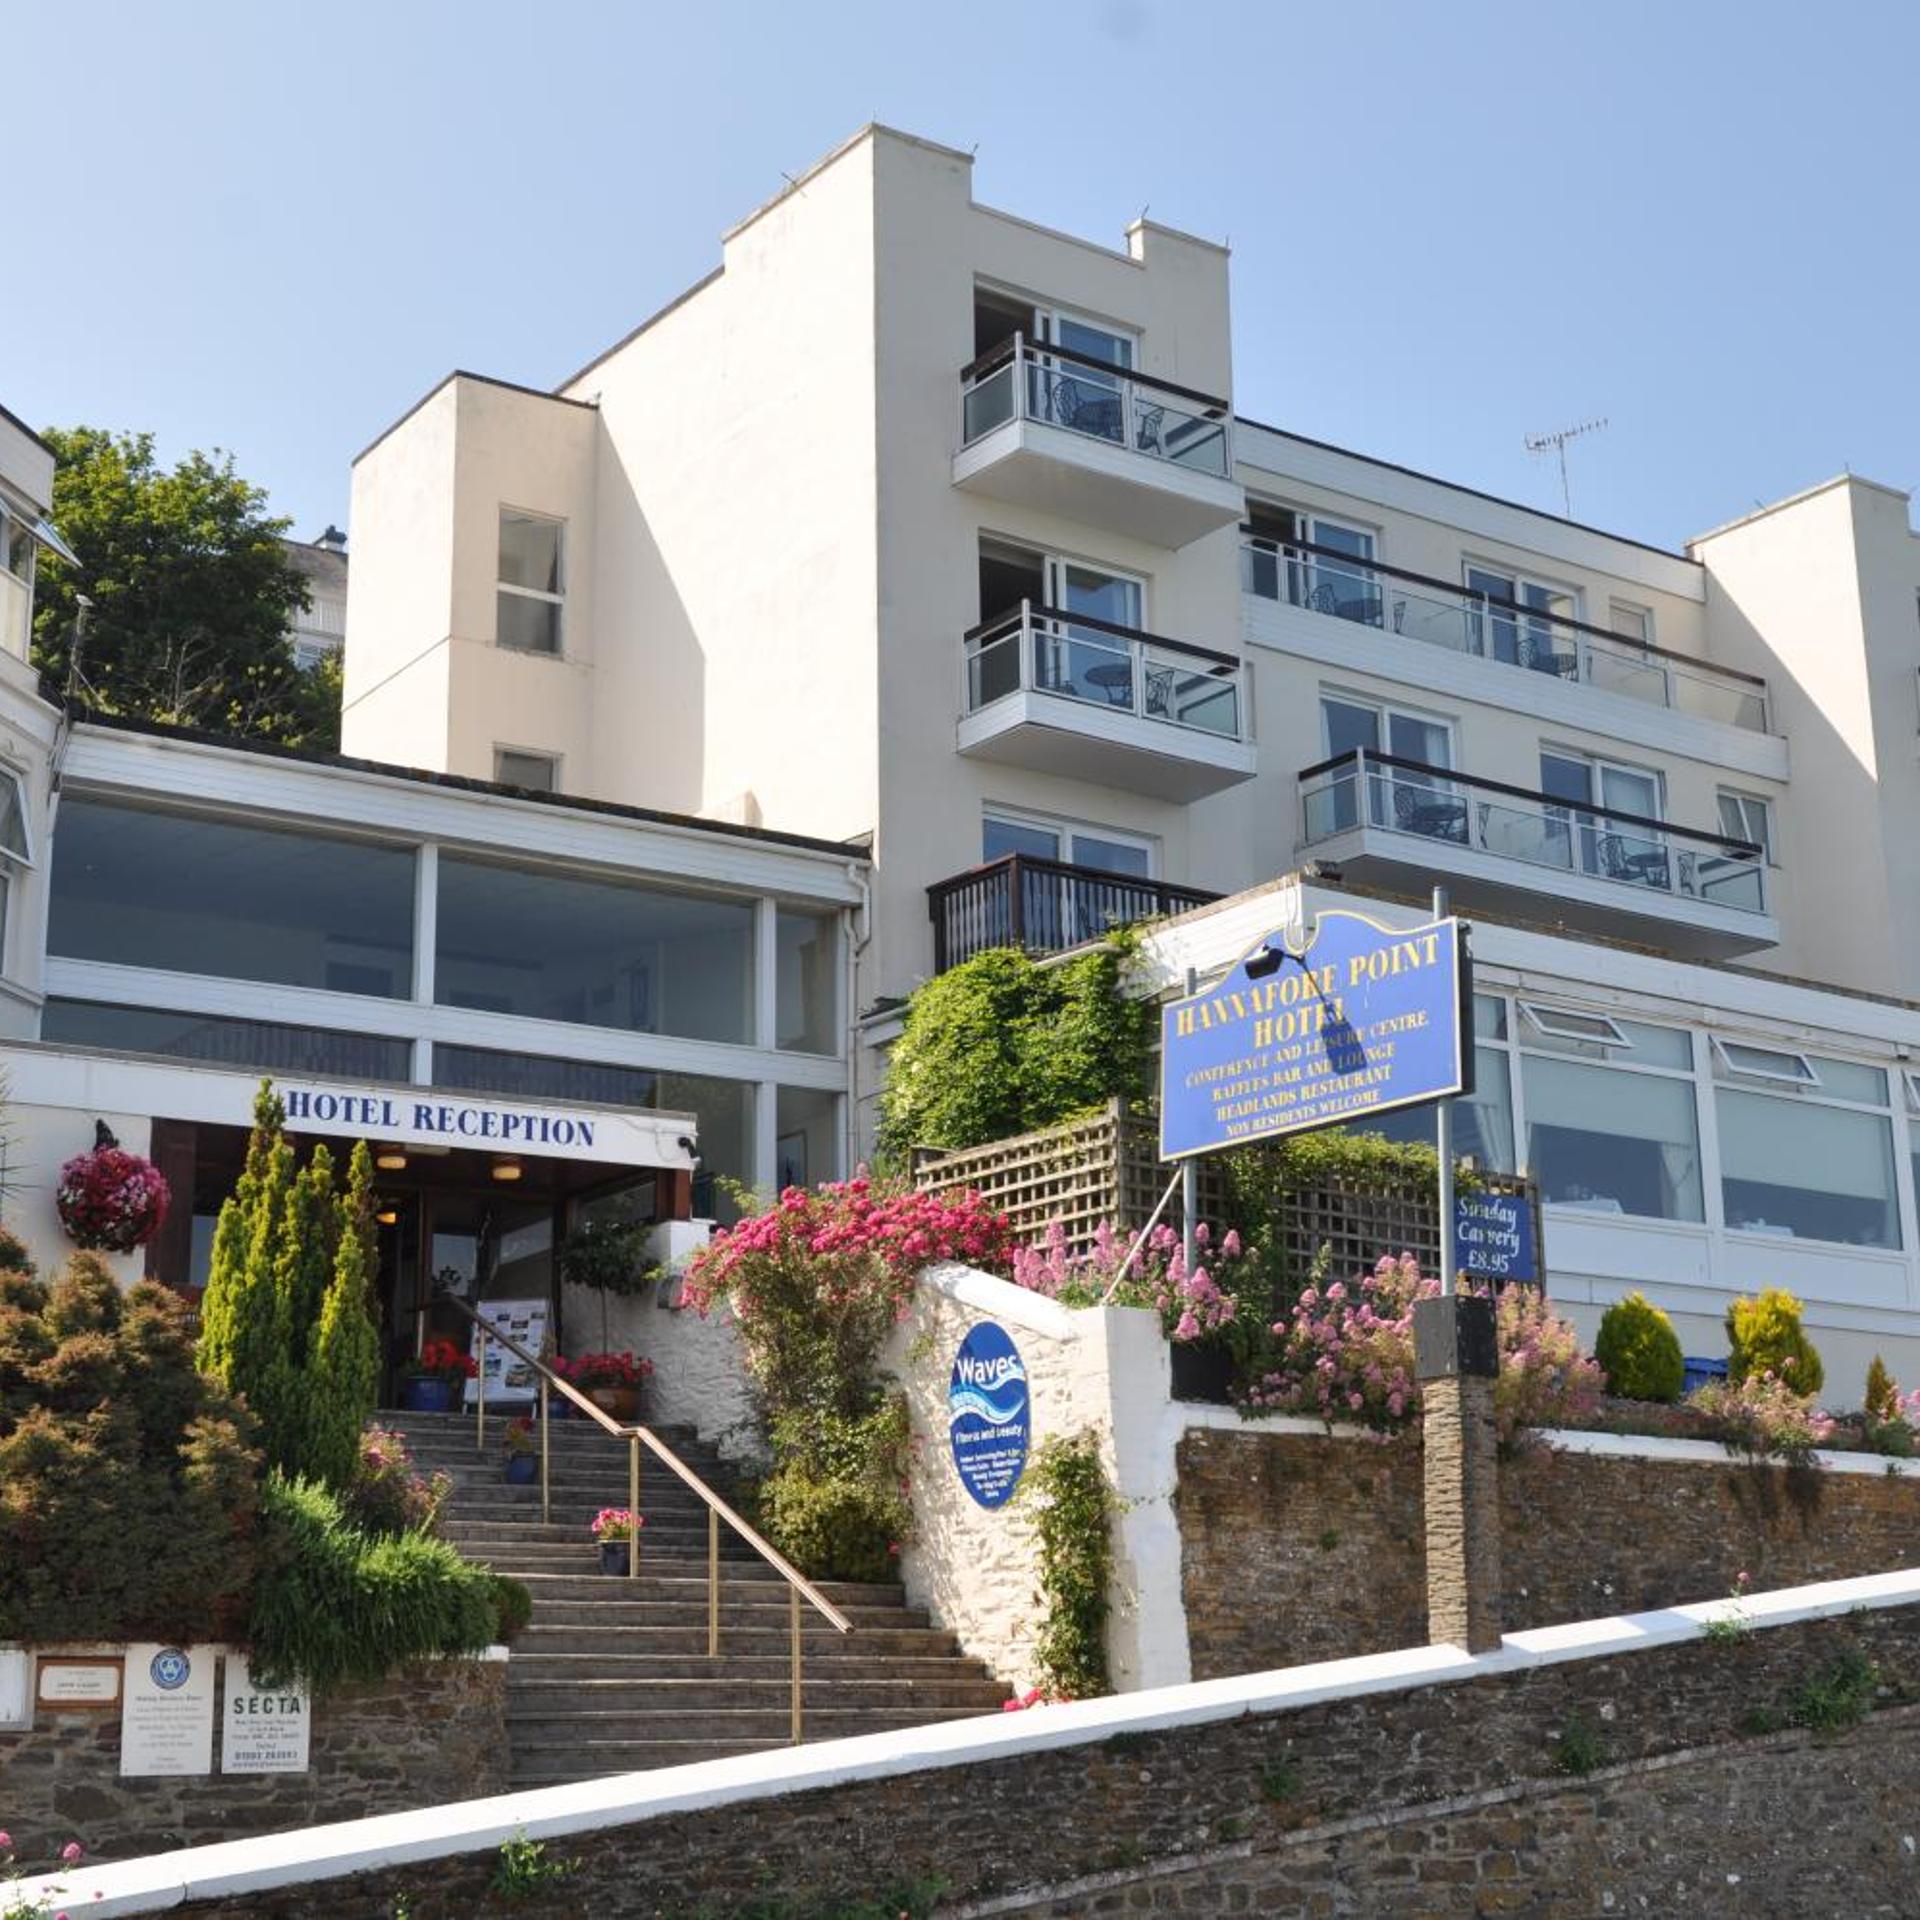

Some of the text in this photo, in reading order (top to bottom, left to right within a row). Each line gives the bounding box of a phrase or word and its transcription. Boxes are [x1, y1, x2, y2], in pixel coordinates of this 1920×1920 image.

[1349, 934, 1439, 987] POINT
[1253, 998, 1345, 1049] HOTEL
[1186, 1055, 1269, 1088] CONFERENCE
[1275, 1044, 1302, 1064] AND
[1369, 1011, 1428, 1039] CENTRE
[1273, 1065, 1301, 1087] BAR
[1306, 1057, 1333, 1078] AND
[1337, 1043, 1396, 1073] LOUNGE
[1216, 1066, 1392, 1122] HEADLANDS RESTAURANT
[1226, 1090, 1381, 1137] NON RESIDENTS WELCOME
[287, 1090, 595, 1147] HOTEL RECEPTION
[1458, 1196, 1517, 1232] Sunday
[1458, 1221, 1520, 1257] Carvery
[1468, 1249, 1509, 1273] £8.95
[957, 1354, 1018, 1386] Waves
[233, 1696, 301, 1715] SECTA
